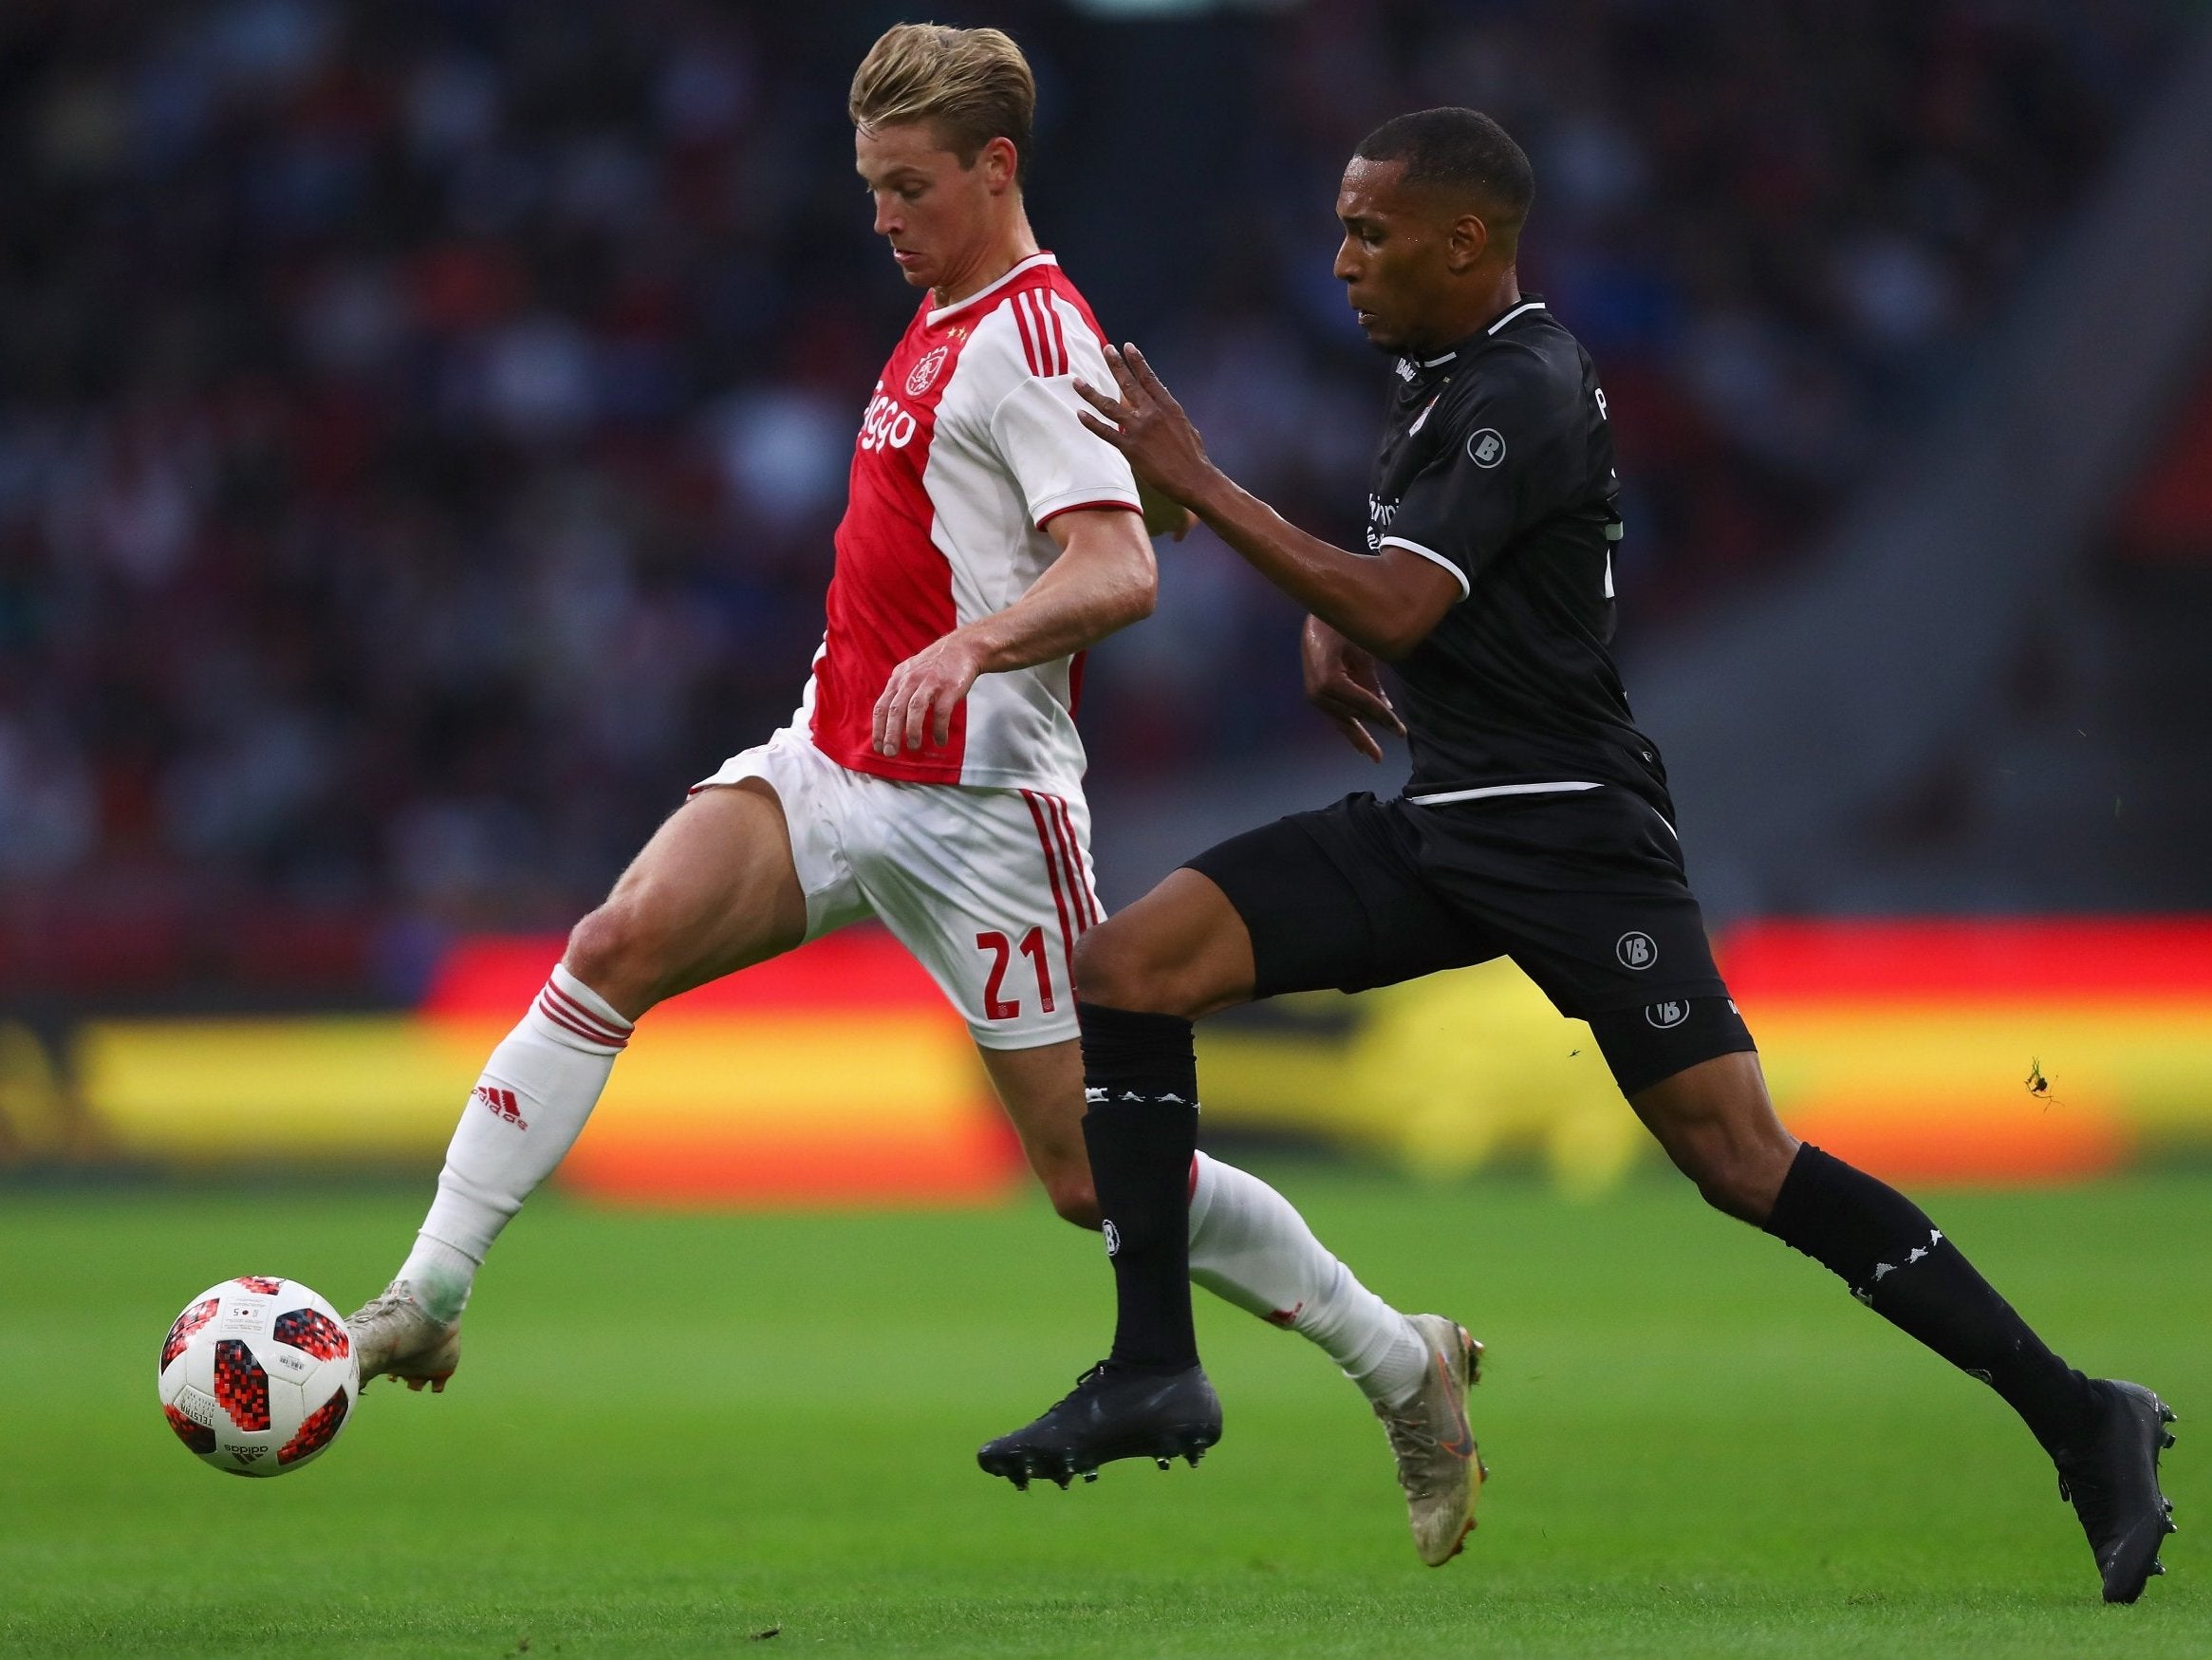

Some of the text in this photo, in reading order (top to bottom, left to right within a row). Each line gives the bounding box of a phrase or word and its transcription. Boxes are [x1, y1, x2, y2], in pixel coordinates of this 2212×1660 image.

[976, 925, 1056, 1021] 21
[471, 1089, 529, 1131] adidas
[180, 1403, 214, 1427] TELSTAR
[224, 1444, 270, 1455] adidas
